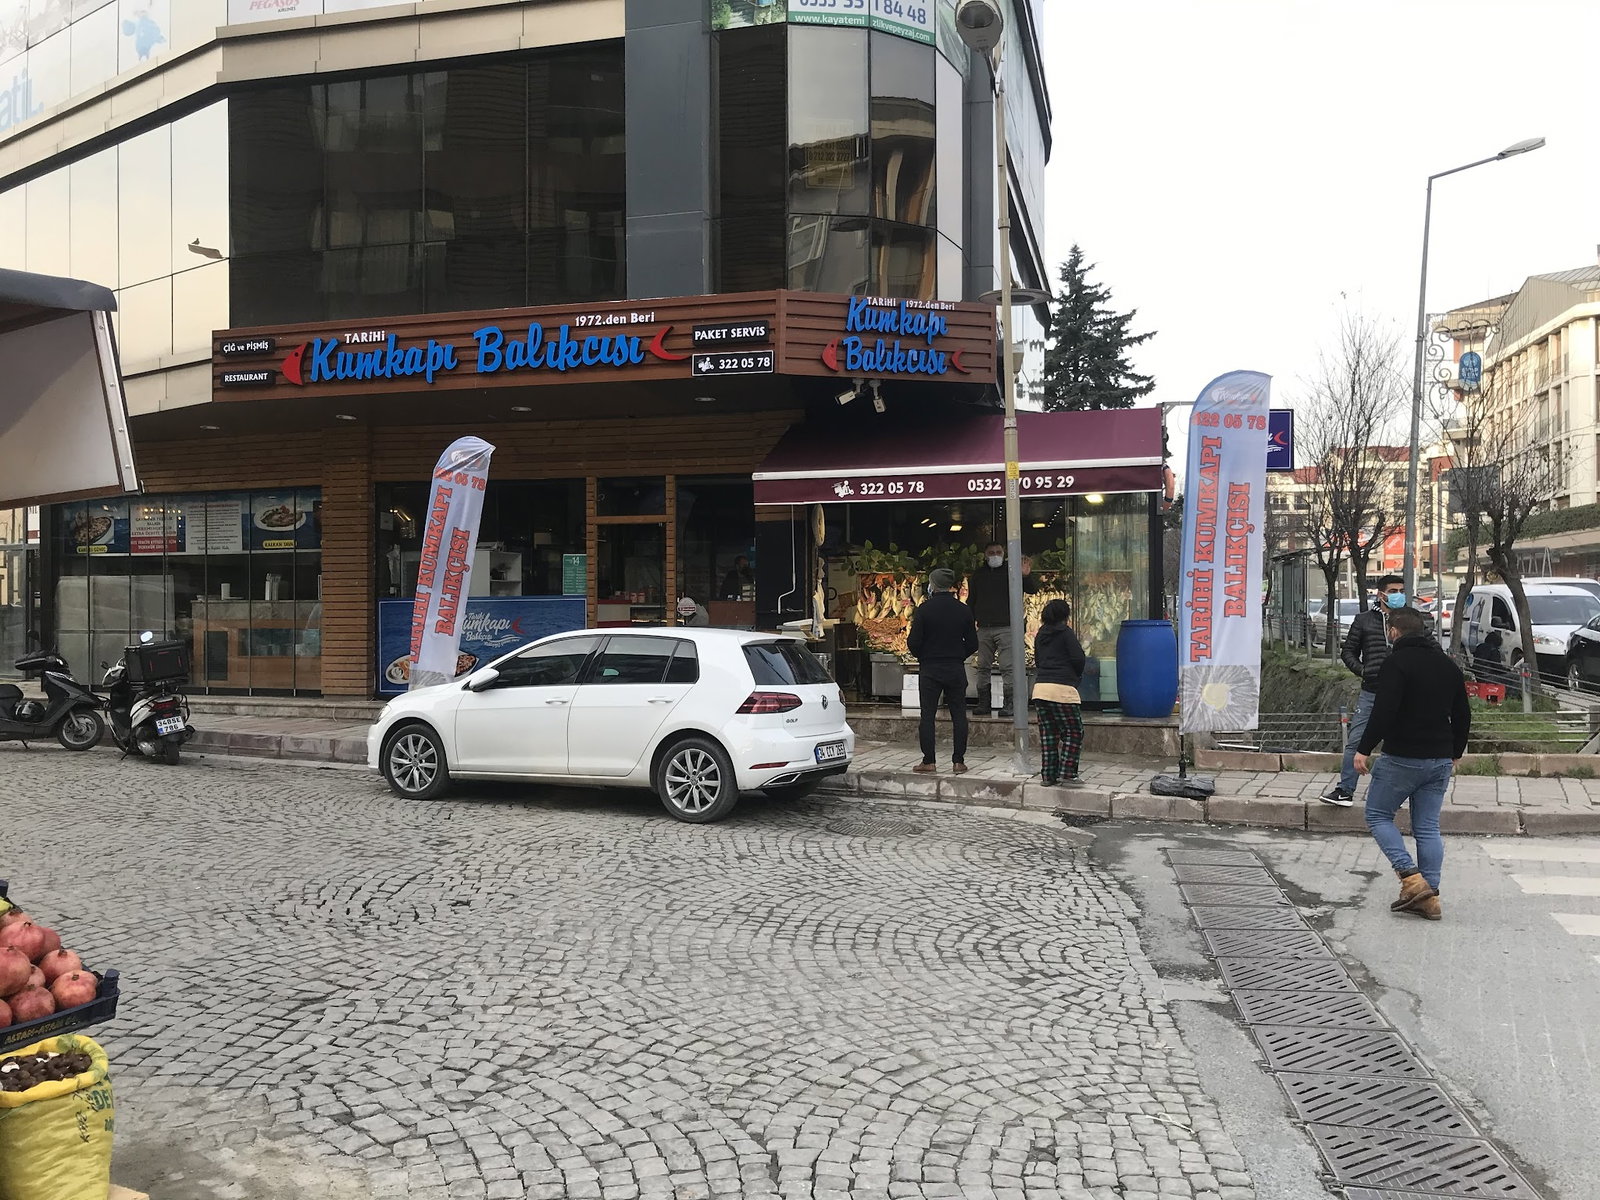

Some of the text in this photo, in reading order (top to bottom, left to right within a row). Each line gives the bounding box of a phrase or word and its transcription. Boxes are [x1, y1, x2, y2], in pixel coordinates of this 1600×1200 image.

[907, 5, 927, 24] 48
[941, 303, 955, 311] Beri
[575, 311, 655, 327] 1972.den Beri
[846, 296, 948, 345] Kumkapı
[694, 328, 728, 341] PAKET
[310, 334, 458, 384] Kumkapı
[719, 357, 770, 369] 322 05 78
[224, 372, 268, 382] RESTAURANT
[1224, 413, 1242, 429] 05
[1247, 415, 1266, 430] 78
[860, 481, 925, 495] 322 05 78
[968, 478, 1001, 491] 0532
[1035, 476, 1053, 488] 95
[1056, 475, 1074, 488] 29
[1194, 435, 1222, 562] KUMKAPI
[1224, 482, 1254, 618] BALIKÇISI
[435, 527, 470, 636] BALIKÇISI
[463, 613, 511, 635] umkapı
